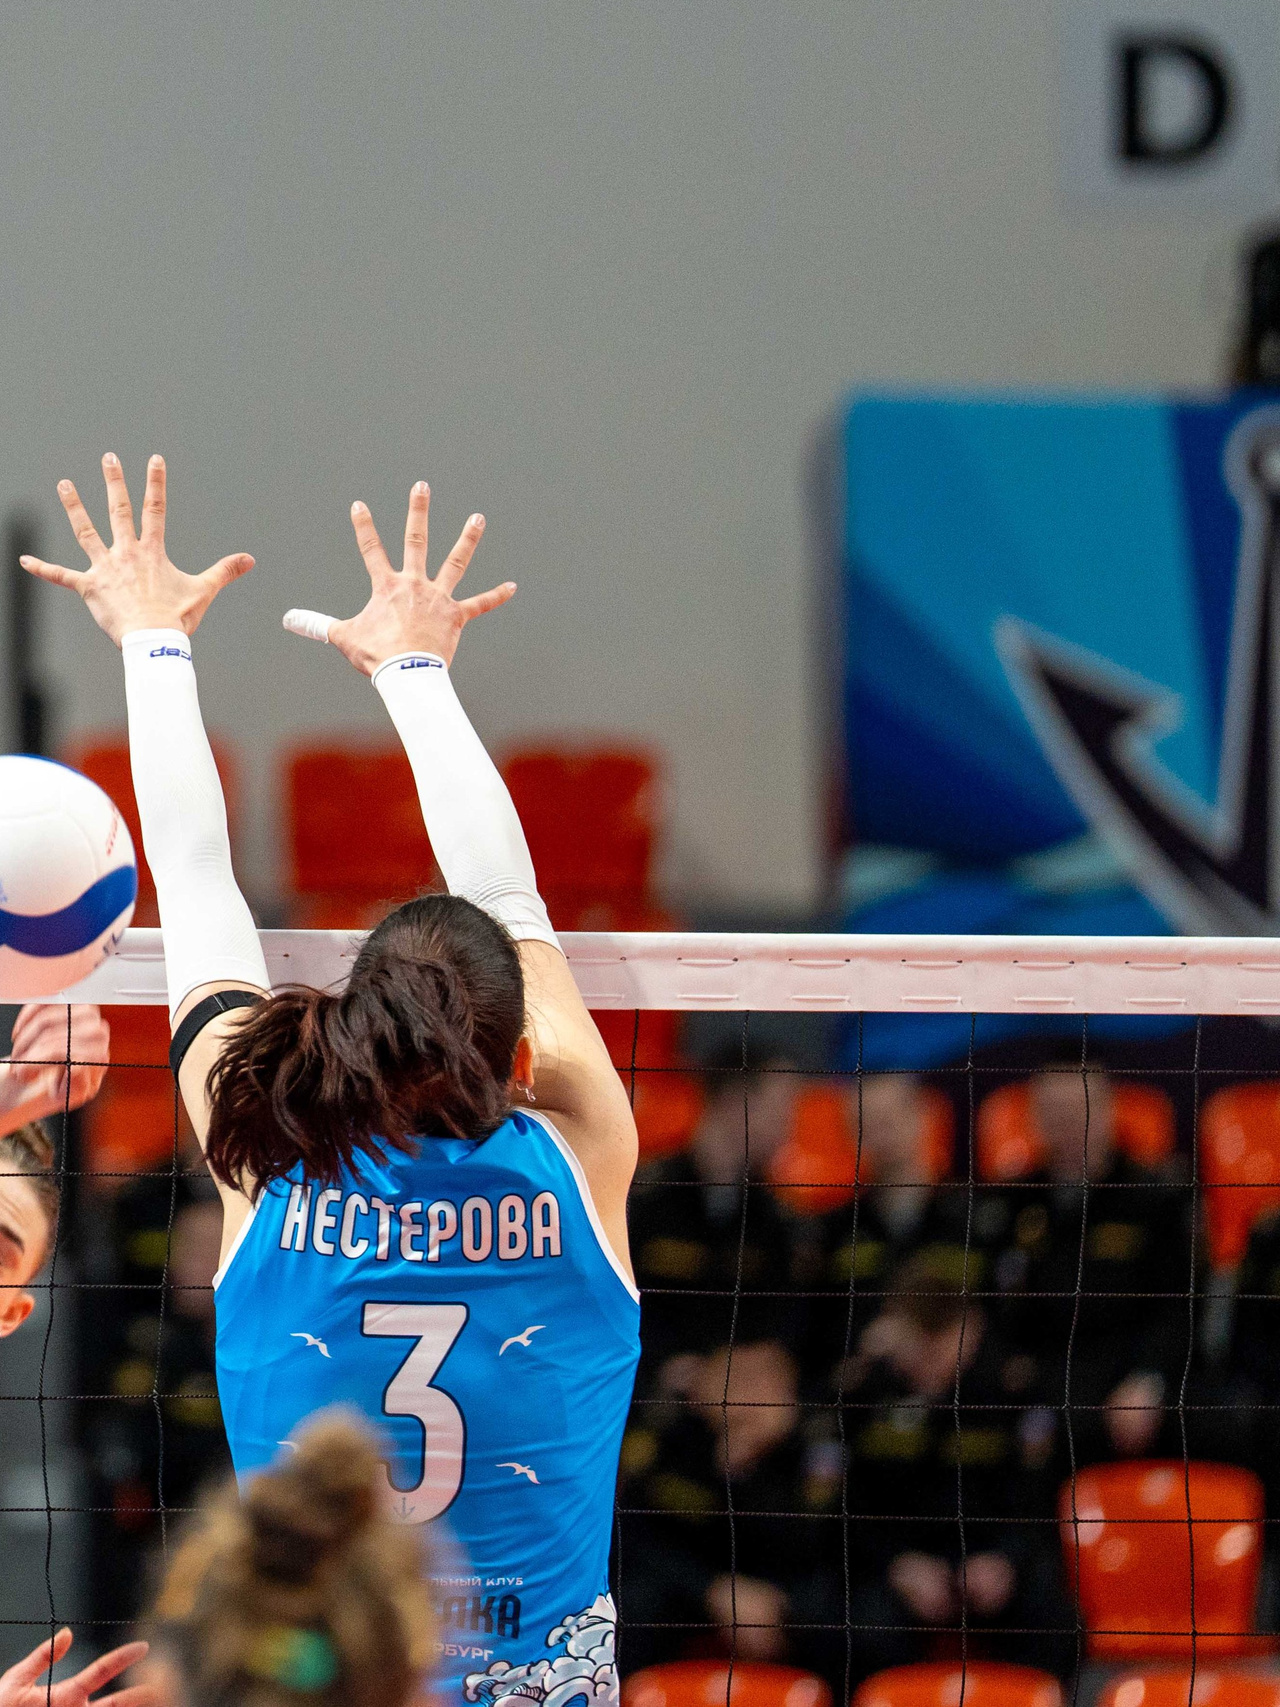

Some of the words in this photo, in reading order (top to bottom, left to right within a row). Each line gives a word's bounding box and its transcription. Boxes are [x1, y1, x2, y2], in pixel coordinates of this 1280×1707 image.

[1116, 35, 1233, 167] D
[279, 1184, 562, 1262] НЕСТЕРОВА
[361, 1300, 468, 1526] 3
[486, 1576, 524, 1586] КЛУБ
[433, 1642, 495, 1662] РБУРГ
